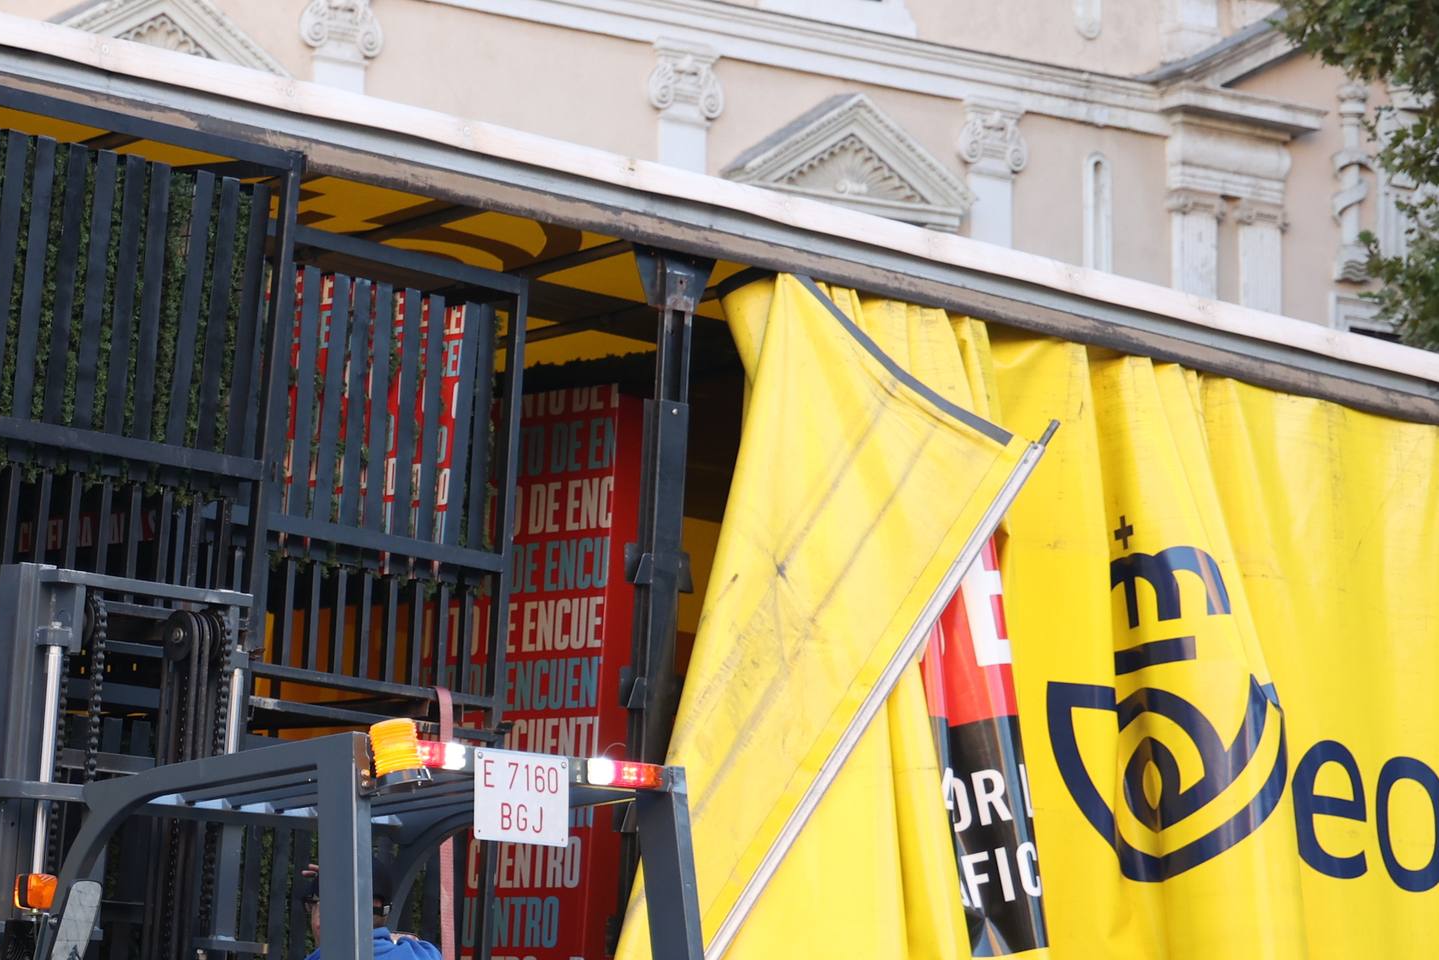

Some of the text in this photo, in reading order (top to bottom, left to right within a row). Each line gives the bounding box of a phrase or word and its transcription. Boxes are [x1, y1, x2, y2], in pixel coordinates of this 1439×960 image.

[528, 482, 562, 535] DE
[543, 536, 610, 592] ENCU
[521, 596, 604, 653] ENCUE
[483, 759, 559, 795] E 7160
[500, 802, 544, 834] BGJ
